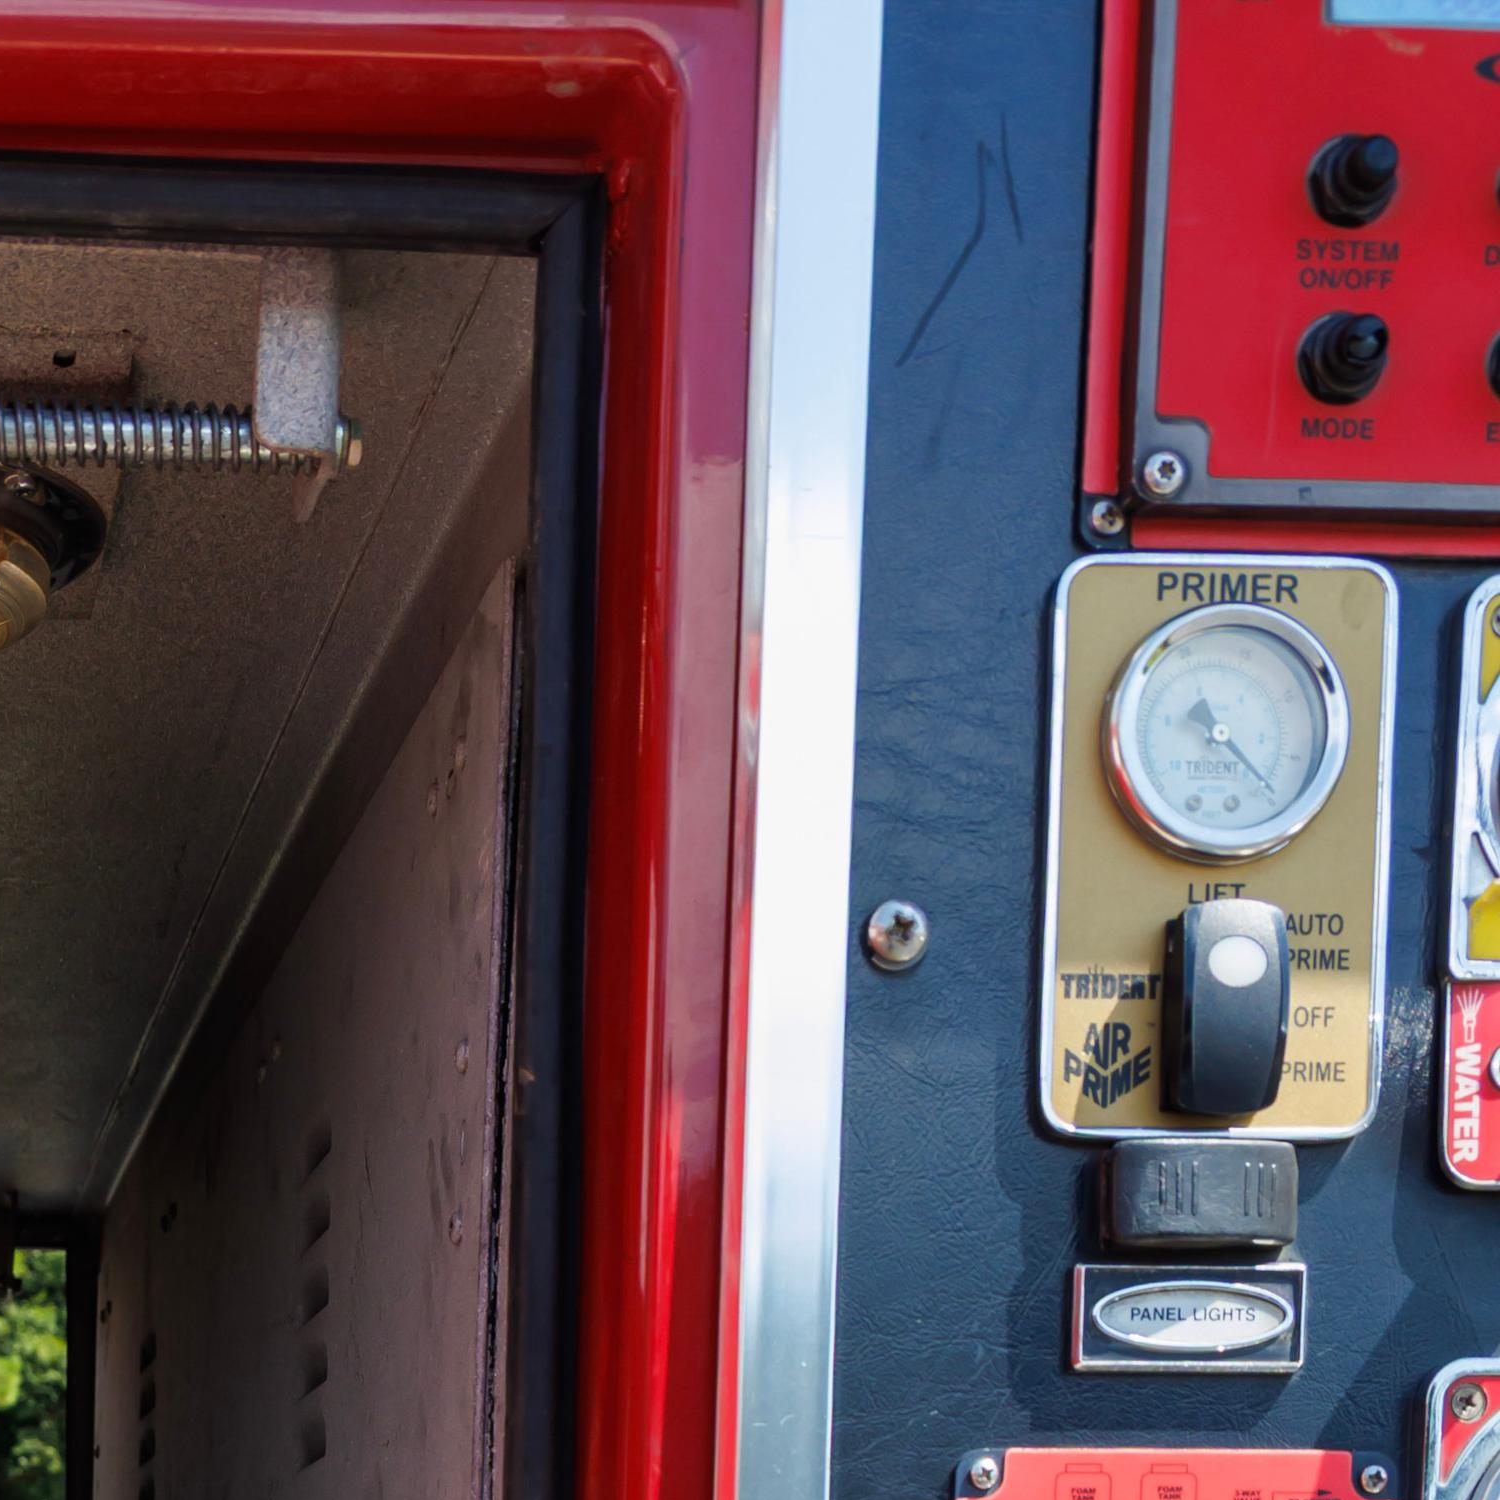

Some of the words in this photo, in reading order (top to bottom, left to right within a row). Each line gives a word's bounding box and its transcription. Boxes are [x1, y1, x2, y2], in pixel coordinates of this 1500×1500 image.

[1296, 240, 1399, 262] SYSTEM
[1299, 268, 1395, 288] ON/OFF
[1301, 418, 1375, 440] MODE
[1156, 573, 1299, 604] PRIMER
[1186, 760, 1240, 774] TRIDENT
[1286, 913, 1344, 936] AUTO
[1287, 949, 1350, 971] PRIME
[1061, 968, 1161, 1000] TRIDENT
[1293, 1006, 1336, 1028] OFF
[1083, 1022, 1132, 1071] AIR
[1063, 1045, 1152, 1109] PRIME
[1282, 1061, 1345, 1082] PRIME
[1452, 1042, 1484, 1164] WATER
[1129, 1306, 1187, 1323] PANEL
[1193, 1306, 1256, 1324] LIGHTS
[1070, 1487, 1096, 1495] FOAM
